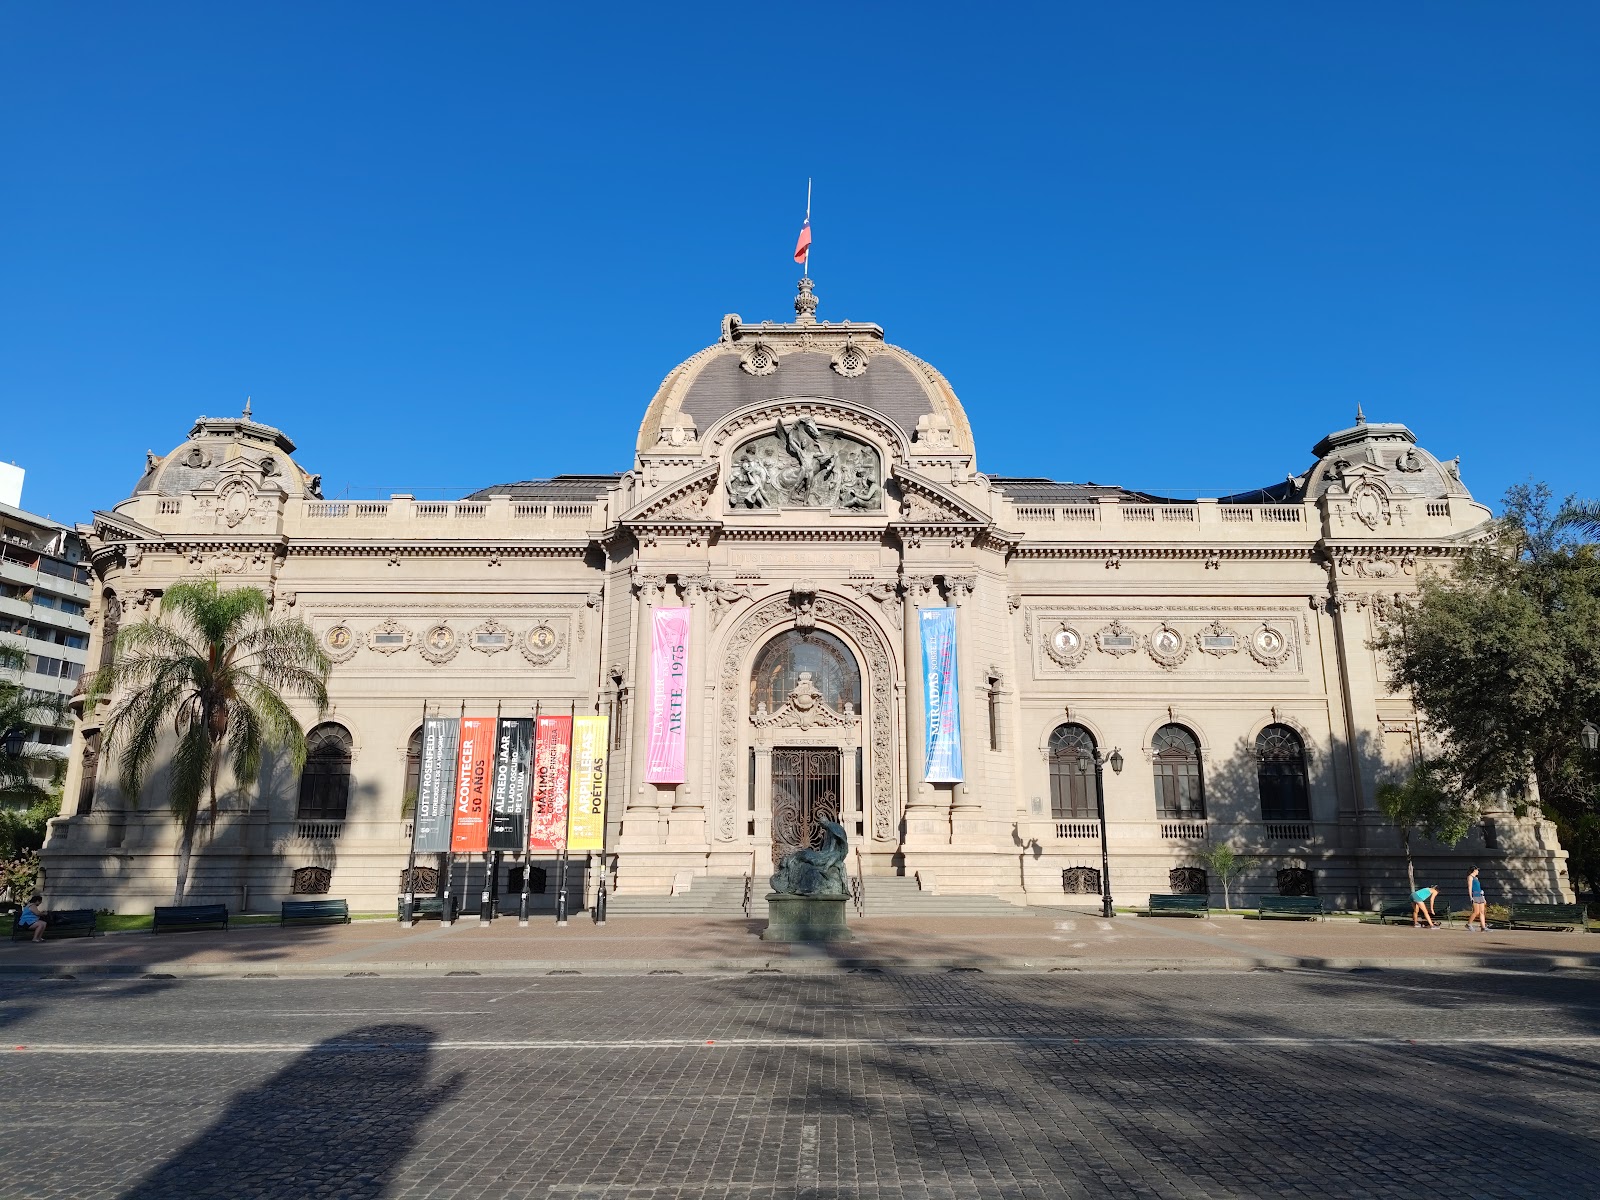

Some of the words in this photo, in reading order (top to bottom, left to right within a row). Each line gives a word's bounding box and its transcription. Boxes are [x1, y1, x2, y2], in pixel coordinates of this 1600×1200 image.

[671, 645, 684, 679] 1975
[930, 645, 938, 670] SOBRE
[655, 678, 666, 718] MUJER
[670, 688, 683, 736] ARTE
[928, 672, 940, 735] MIRADAS
[654, 722, 663, 736] LA
[423, 734, 435, 787] ROSENFELD
[499, 735, 511, 763] JAAR
[510, 751, 518, 782] OSCURO
[458, 739, 474, 813] ACONTECER
[472, 760, 485, 794] AÑOS
[495, 765, 507, 813] ALFREDO
[517, 771, 525, 790] LUNA
[536, 766, 549, 814] MÁXIMO
[579, 733, 593, 814] ARPILLERAS
[590, 757, 604, 815] POÉTICAS
[420, 789, 431, 817] LOTTY
[472, 798, 482, 813] 50
